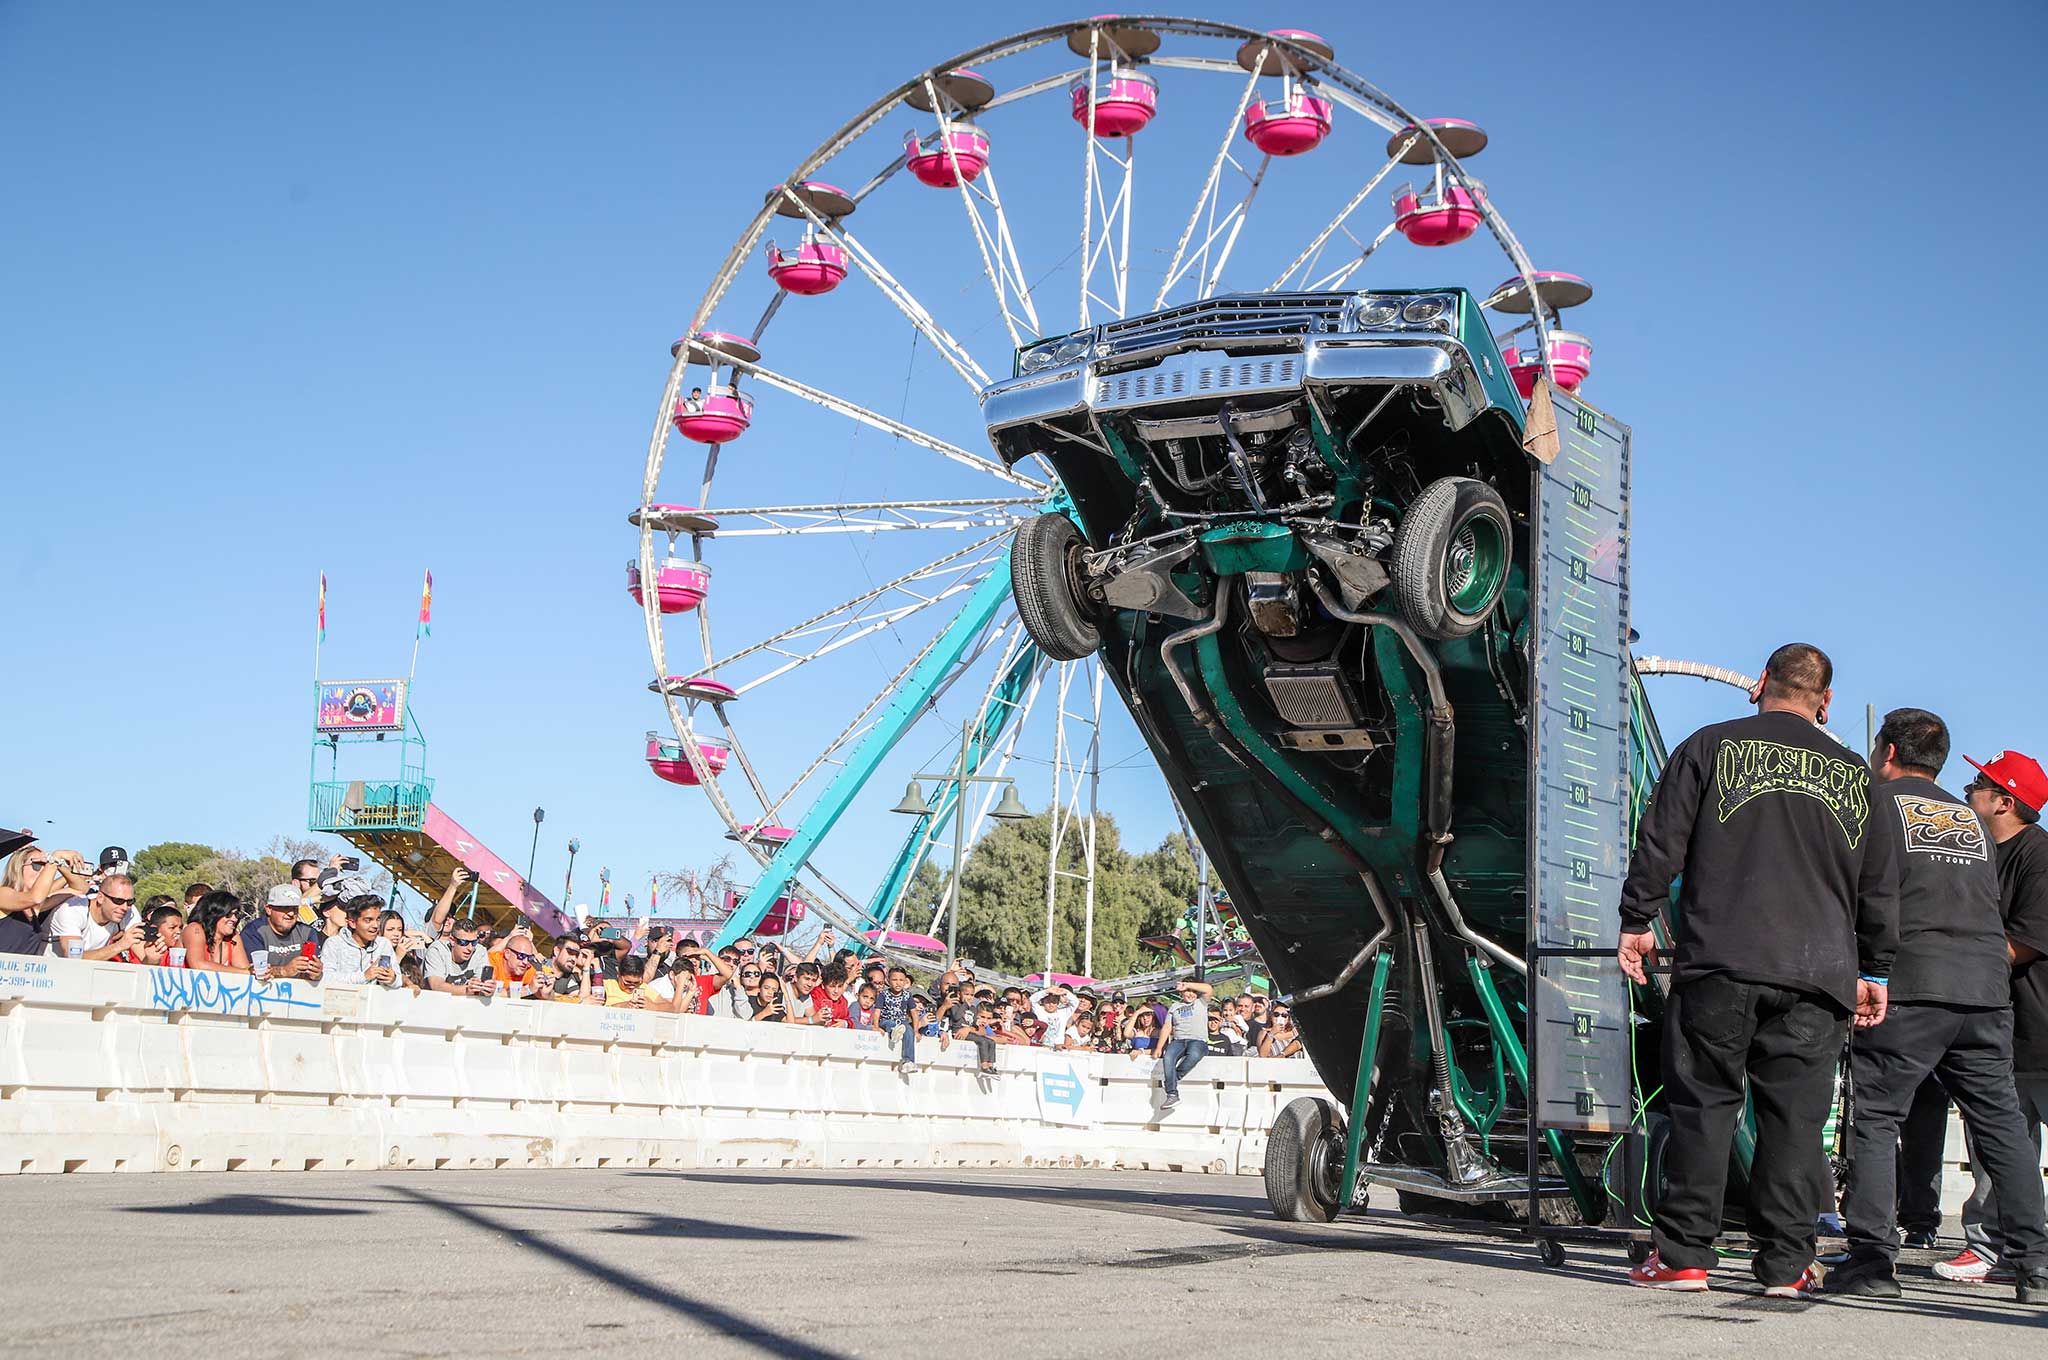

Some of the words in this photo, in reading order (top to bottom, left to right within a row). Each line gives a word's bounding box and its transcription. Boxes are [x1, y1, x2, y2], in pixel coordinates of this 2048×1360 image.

[1579, 412, 1594, 433] 110
[1574, 487, 1590, 507] 100
[1573, 559, 1583, 578] 90
[1618, 432, 1629, 704] HYDRAULICS
[1572, 635, 1582, 654] 80
[1573, 710, 1584, 729] 70
[1574, 786, 1585, 805] 60
[1750, 777, 1785, 793] SAN
[1788, 779, 1841, 811] DIEGO
[1930, 854, 1942, 862] ST
[1945, 855, 1971, 866] JOHN
[1575, 861, 1586, 880] 50
[24, 962, 47, 973] STAR
[1576, 1015, 1587, 1034] 30
